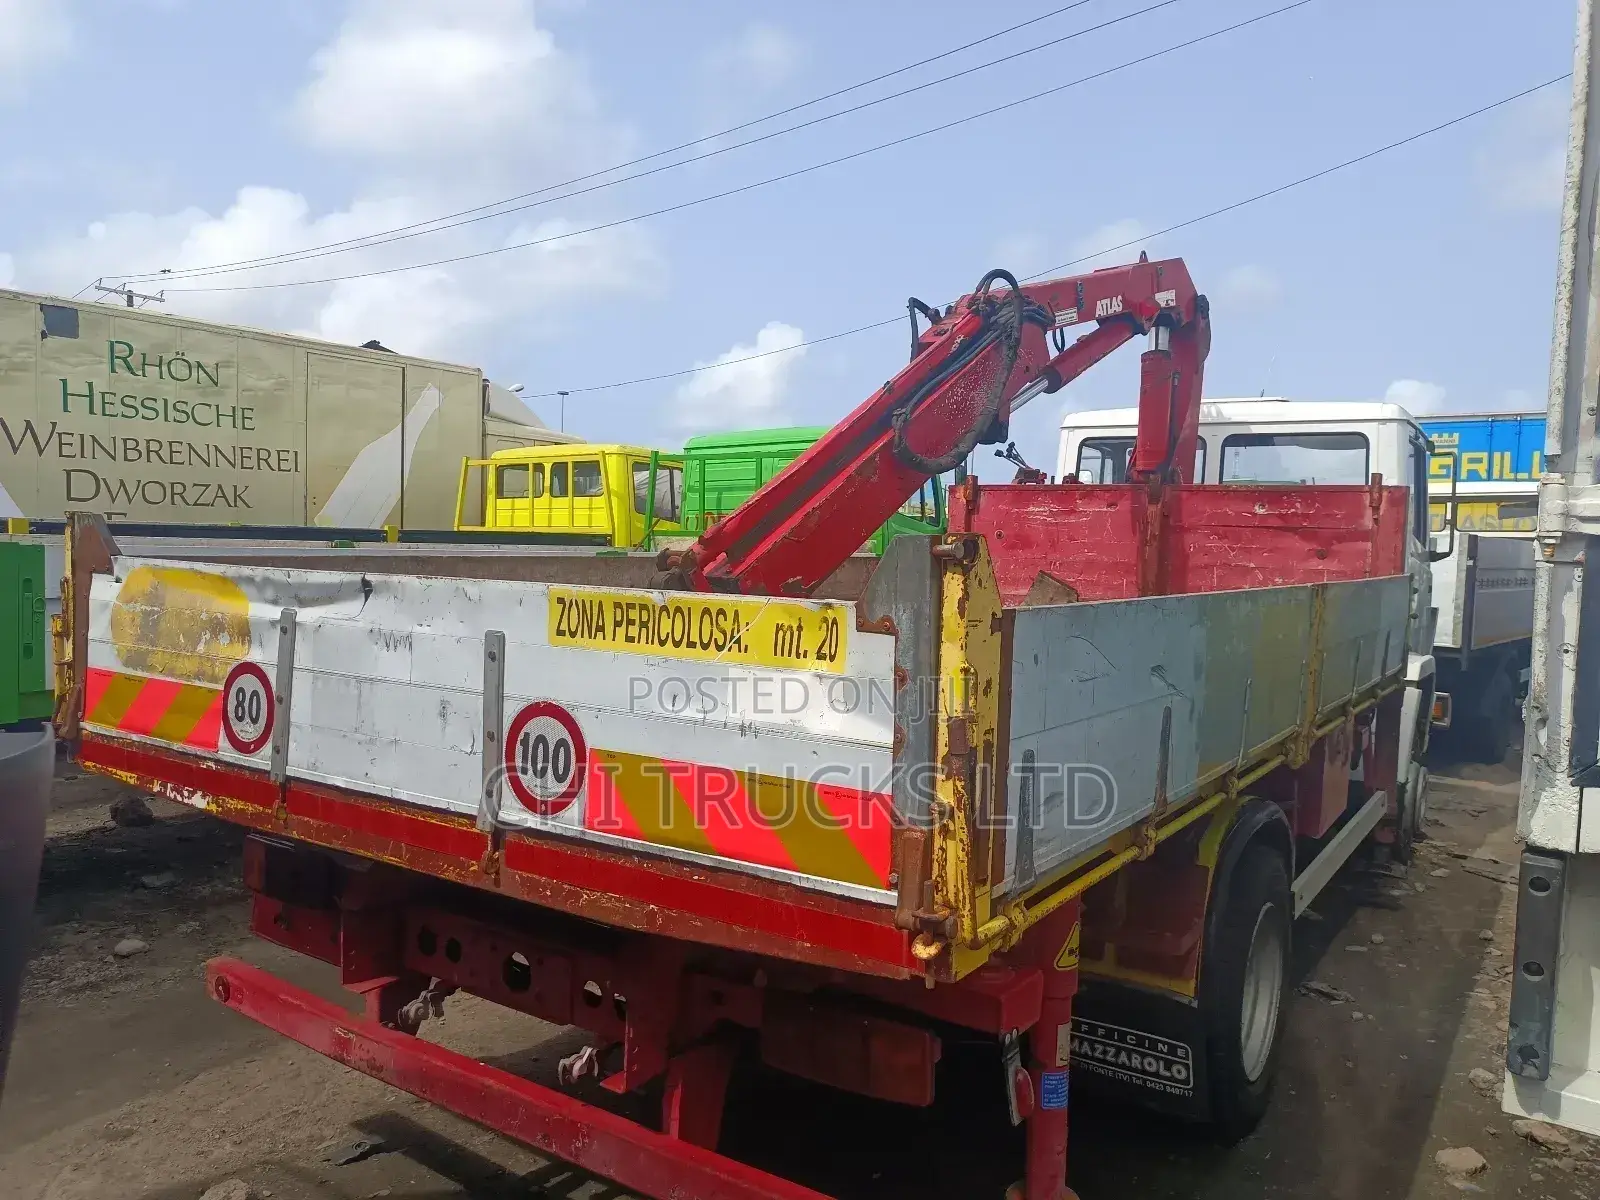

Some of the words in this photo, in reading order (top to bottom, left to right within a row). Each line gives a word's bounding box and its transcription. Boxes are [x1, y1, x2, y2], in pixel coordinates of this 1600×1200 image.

[1095, 295, 1123, 318] ATLAS
[106, 339, 221, 387] RHÖN
[58, 378, 256, 431] HESSISCHE
[0, 416, 301, 473] WEINBRENNEREI
[62, 468, 253, 509] DWORZAK
[555, 596, 606, 641] ZONA
[611, 601, 749, 654] PERICOLOSA:
[773, 616, 808, 659] mt.
[816, 615, 839, 663] 20
[234, 686, 261, 725] 80
[519, 731, 572, 784] 100
[1081, 1024, 1187, 1058] FFICINE
